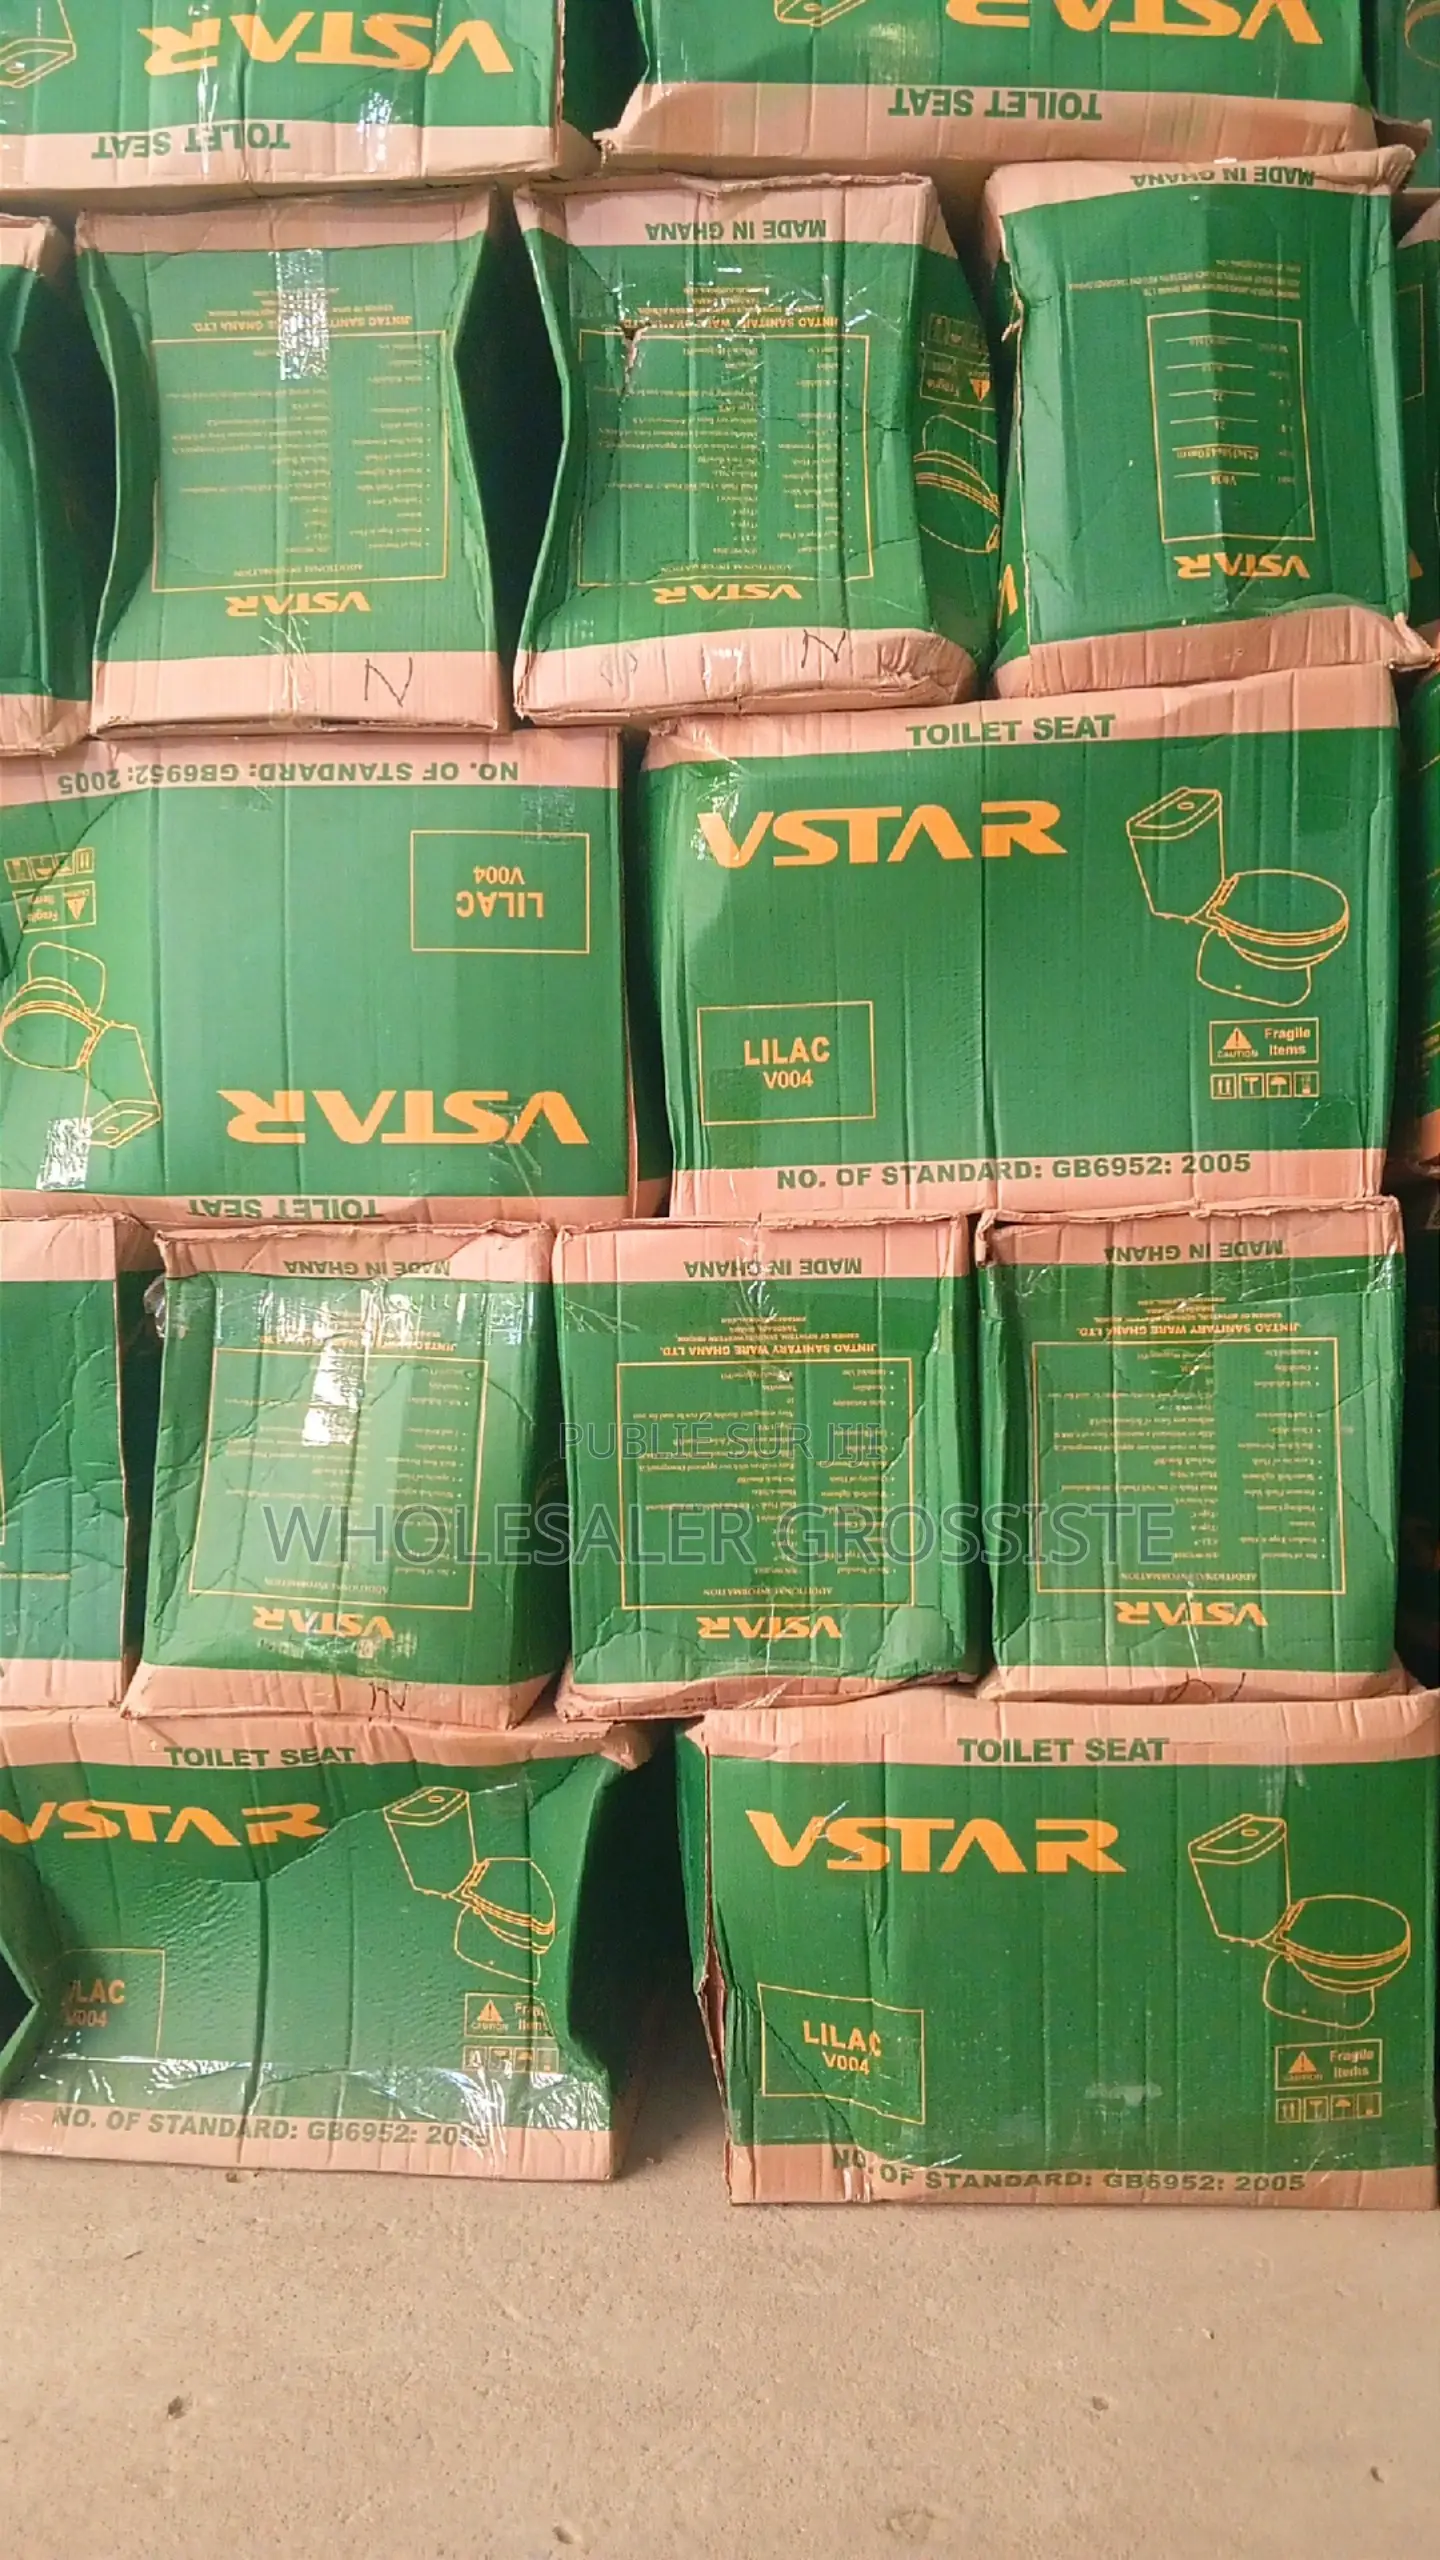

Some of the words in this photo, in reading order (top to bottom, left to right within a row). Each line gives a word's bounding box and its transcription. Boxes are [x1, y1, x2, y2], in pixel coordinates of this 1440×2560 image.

[138, 12, 514, 77] VSTAR
[889, 87, 974, 117] SEAT
[984, 89, 1102, 121] TOILET
[92, 135, 171, 159] SEAT
[183, 123, 291, 153] TOLET
[1222, 167, 1247, 184] IN
[1254, 167, 1315, 187] MADE
[645, 222, 725, 241] GHANA
[732, 220, 755, 240] IN
[763, 219, 827, 240] MADE
[1173, 552, 1311, 580] VSTAR
[225, 591, 371, 617] VSTAR
[651, 583, 802, 605] VSTAR
[906, 718, 1017, 746] TOILET
[1033, 714, 1116, 741] SEAT
[126, 763, 239, 784] GB6952:
[249, 761, 413, 782] STANDARD:
[422, 761, 459, 782] OF
[470, 761, 519, 781] NO.
[58, 769, 119, 795] 2005
[697, 799, 1067, 869] VSTAR
[473, 865, 525, 885] V004
[455, 888, 544, 919] LILAC
[1264, 1026, 1311, 1042] Fragile
[743, 1035, 830, 1066] LILAC
[1269, 1044, 1307, 1056] Items
[763, 1069, 814, 1090] V004
[216, 1088, 591, 1147] VSTAR
[776, 1169, 826, 1190] NO.
[836, 1166, 872, 1187] OF
[880, 1159, 1043, 1187] STANDARD:
[1052, 1156, 1172, 1181] GB6952:
[1181, 1153, 1251, 1175] 2005
[186, 1198, 262, 1220] SEAT
[276, 1198, 380, 1221] TOILET
[1103, 1244, 1182, 1262] GHANA
[1189, 1241, 1211, 1259] IN
[1220, 1239, 1284, 1258] MADE
[283, 1260, 359, 1276] GHANA
[366, 1260, 387, 1276] IN
[393, 1260, 451, 1277] MADE
[683, 1259, 754, 1278] GHANA
[768, 1258, 793, 1276] IN
[800, 1257, 862, 1276] MADE
[1151, 1324, 1187, 1335] WARE
[1190, 1323, 1251, 1334] SANITARY
[660, 1346, 685, 1357] LTD.
[688, 1345, 730, 1356] GHANA
[734, 1344, 769, 1355] WARE
[772, 1343, 831, 1354] SANITARY
[833, 1342, 877, 1352] JINTAO
[252, 1605, 395, 1640] VSTAR
[1113, 1601, 1268, 1626] VSTAR
[695, 1615, 842, 1639] VSTAR
[163, 1746, 270, 1768] TOILET
[281, 1746, 357, 1767] SEAT
[957, 1738, 1071, 1763] TOILET
[1085, 1737, 1170, 1763] SEAT
[745, 1808, 1127, 1874] VSTAR
[802, 2018, 883, 2059] LILAC
[822, 2051, 871, 2077] V004
[1329, 2048, 1375, 2063] Fragile
[52, 2106, 97, 2129] NO.
[107, 2109, 141, 2132] OF
[148, 2114, 299, 2141] STANDARD:
[307, 2119, 418, 2144] GB6952:
[879, 2165, 914, 2185] OF
[926, 2171, 1093, 2191] STANDARD:
[1234, 2173, 1306, 2194] 2005
